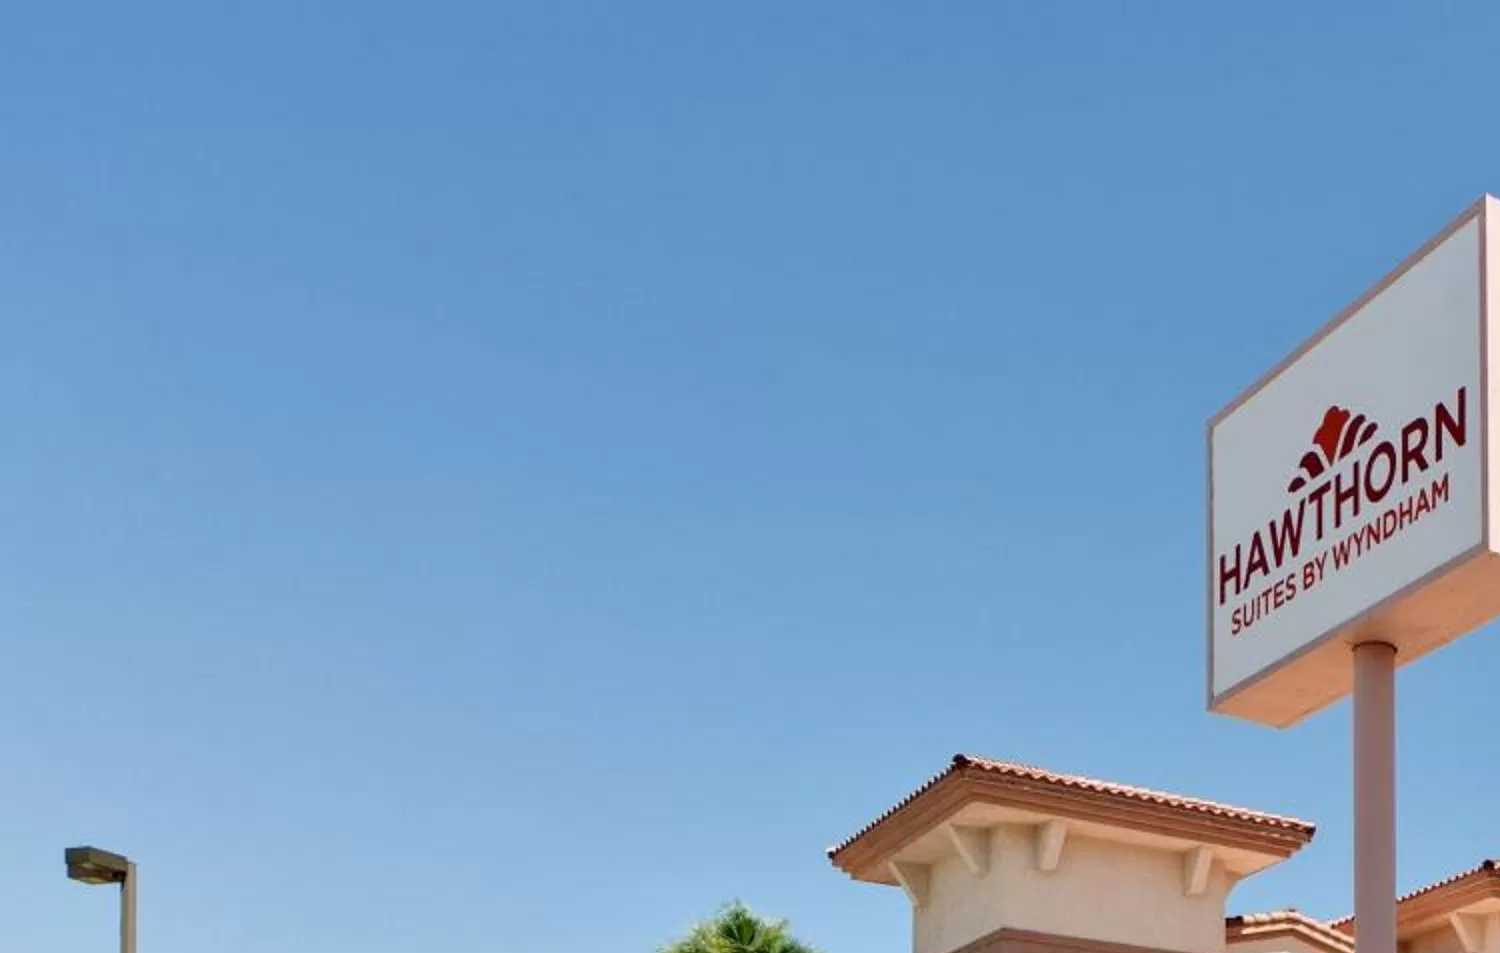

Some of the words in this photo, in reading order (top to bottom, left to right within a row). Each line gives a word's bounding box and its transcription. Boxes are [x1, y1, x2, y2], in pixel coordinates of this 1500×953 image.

[1219, 386, 1466, 604] HAWTHORN
[1231, 573, 1297, 635] SUITES
[1303, 551, 1327, 591] BY
[1332, 472, 1449, 572] WYNDHAM
